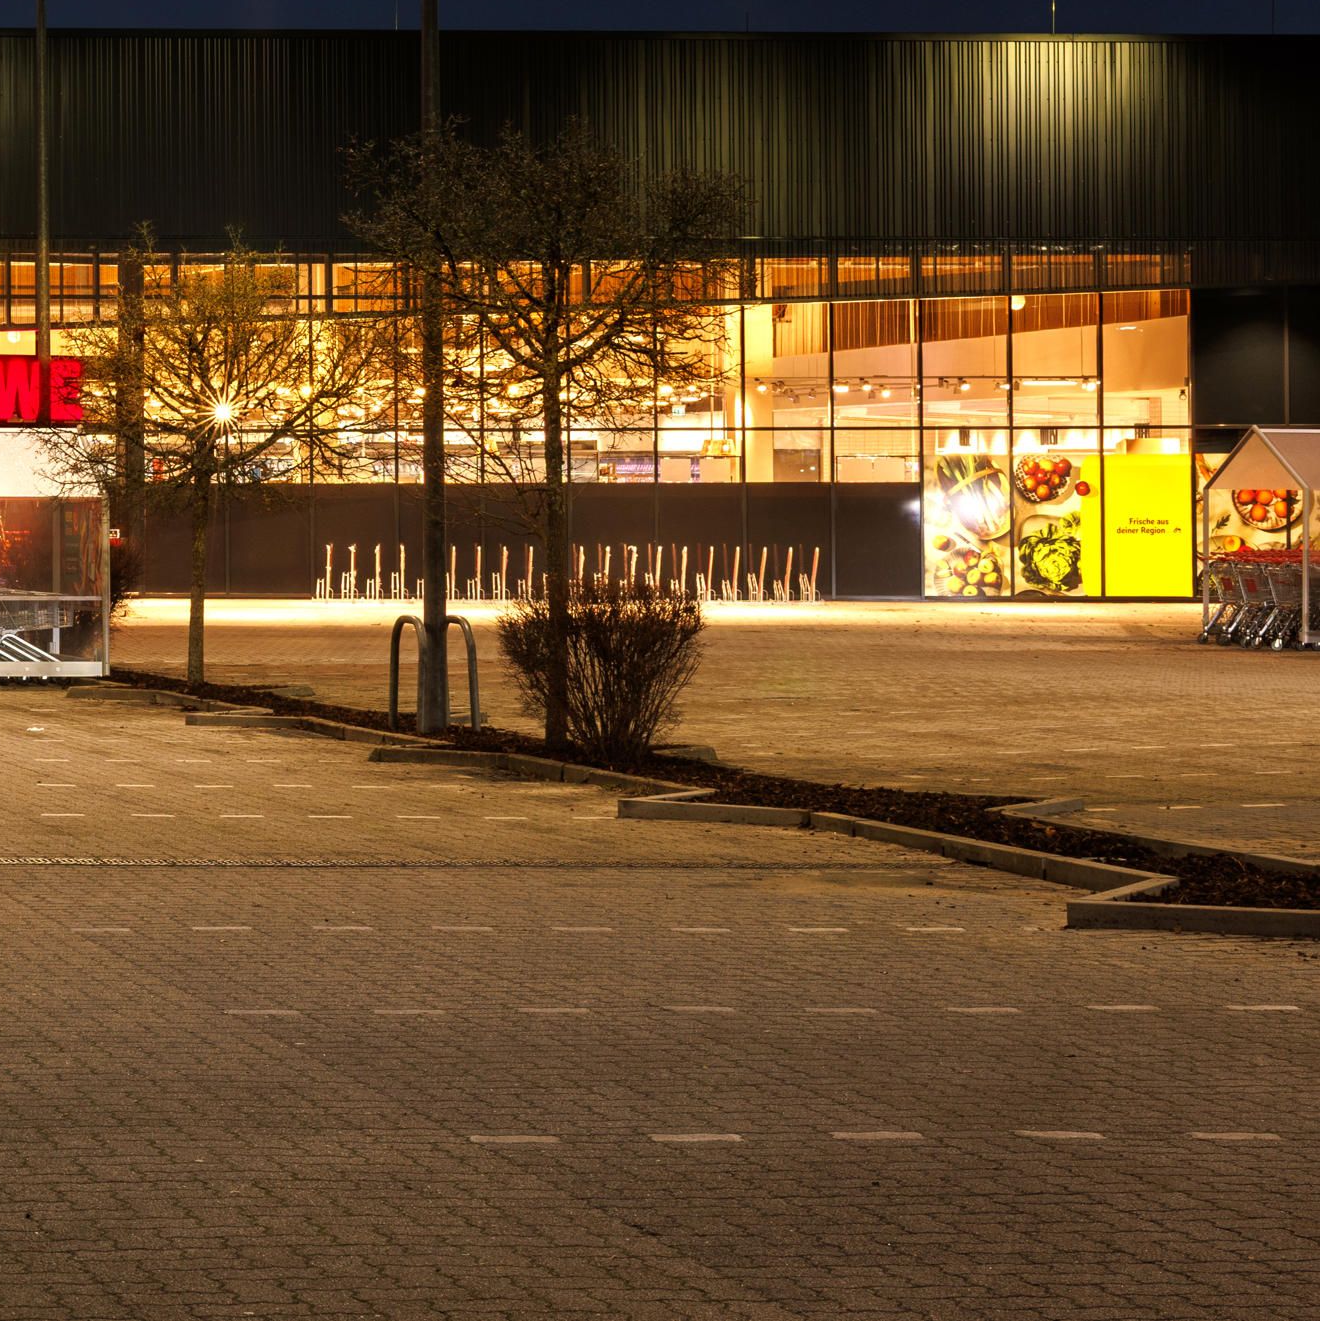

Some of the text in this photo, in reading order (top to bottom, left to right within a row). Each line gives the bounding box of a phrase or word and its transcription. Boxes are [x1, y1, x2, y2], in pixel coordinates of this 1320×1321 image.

[1129, 517, 1155, 525] Frische
[1116, 526, 1166, 535] deiner Region
